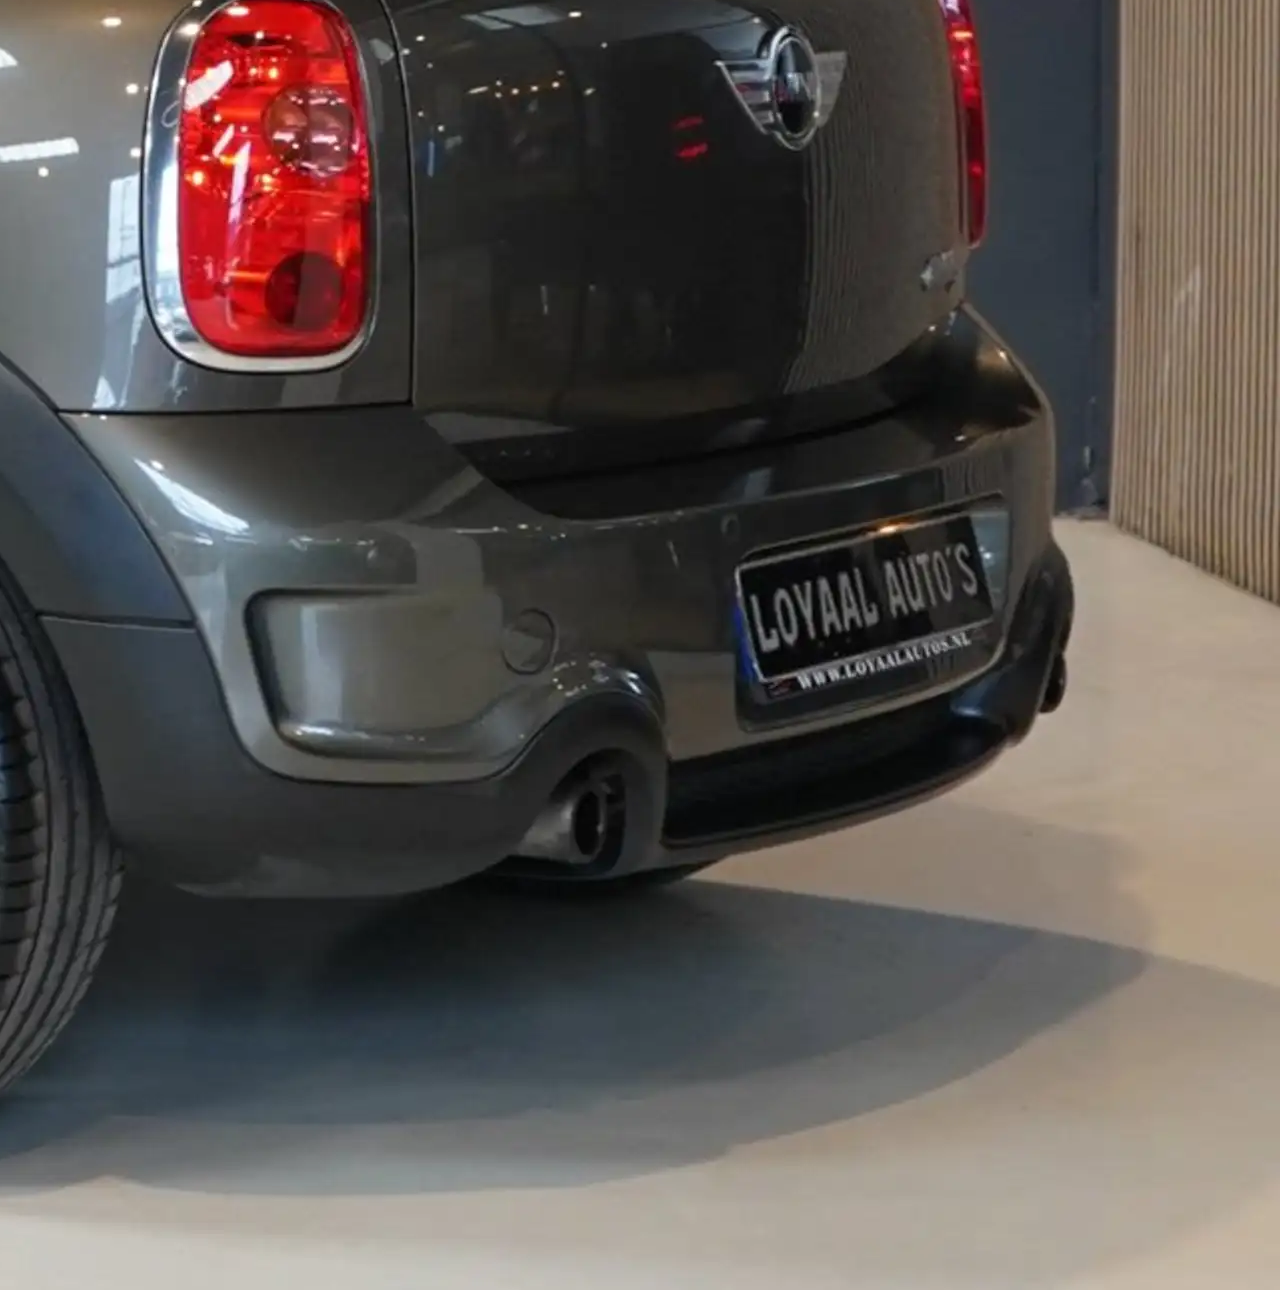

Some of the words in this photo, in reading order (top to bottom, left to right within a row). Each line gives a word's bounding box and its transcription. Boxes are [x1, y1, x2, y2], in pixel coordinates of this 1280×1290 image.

[751, 567, 878, 653] LOYAAL
[886, 542, 978, 618] AUTO'S
[796, 631, 972, 691] WWW.LOYAALAUTOS.NL
